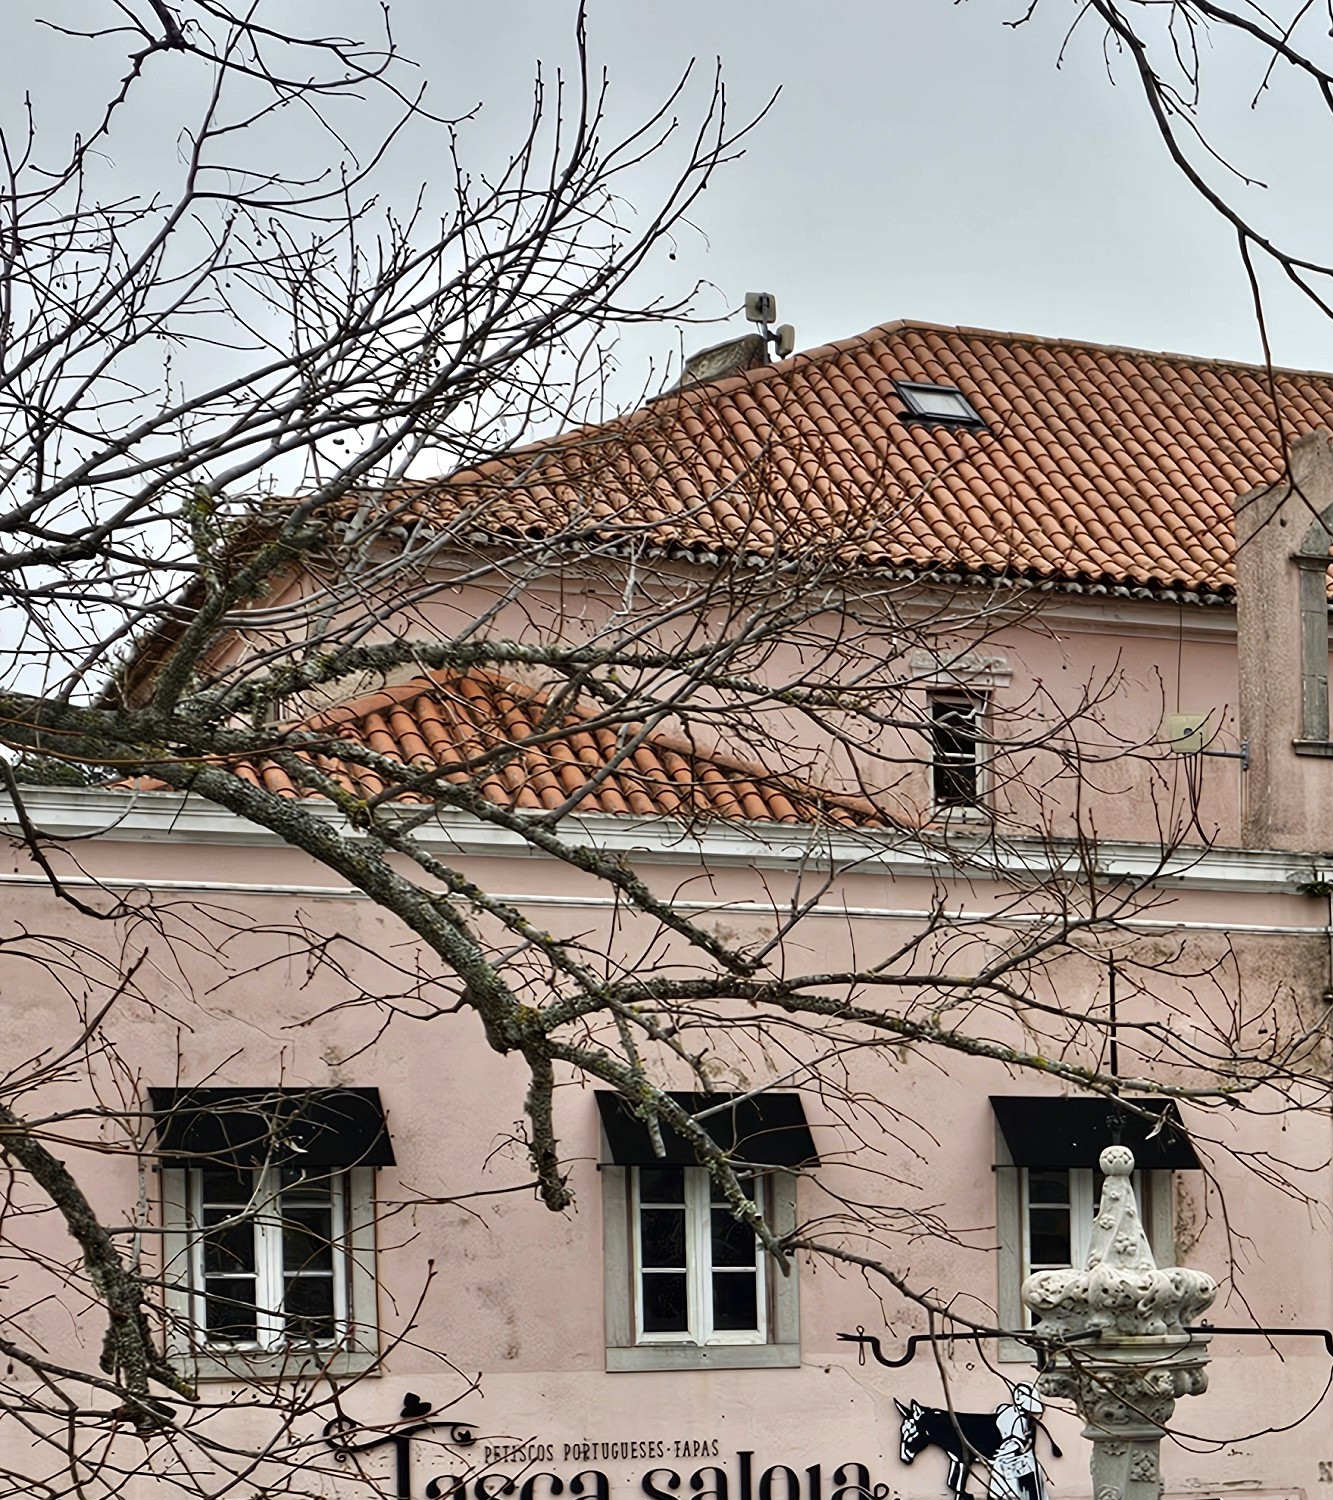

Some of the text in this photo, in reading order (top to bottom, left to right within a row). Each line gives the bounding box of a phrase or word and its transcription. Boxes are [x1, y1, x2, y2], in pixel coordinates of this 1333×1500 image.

[484, 1439, 720, 1465] PETISCOS PORTUGUESES TAPAS
